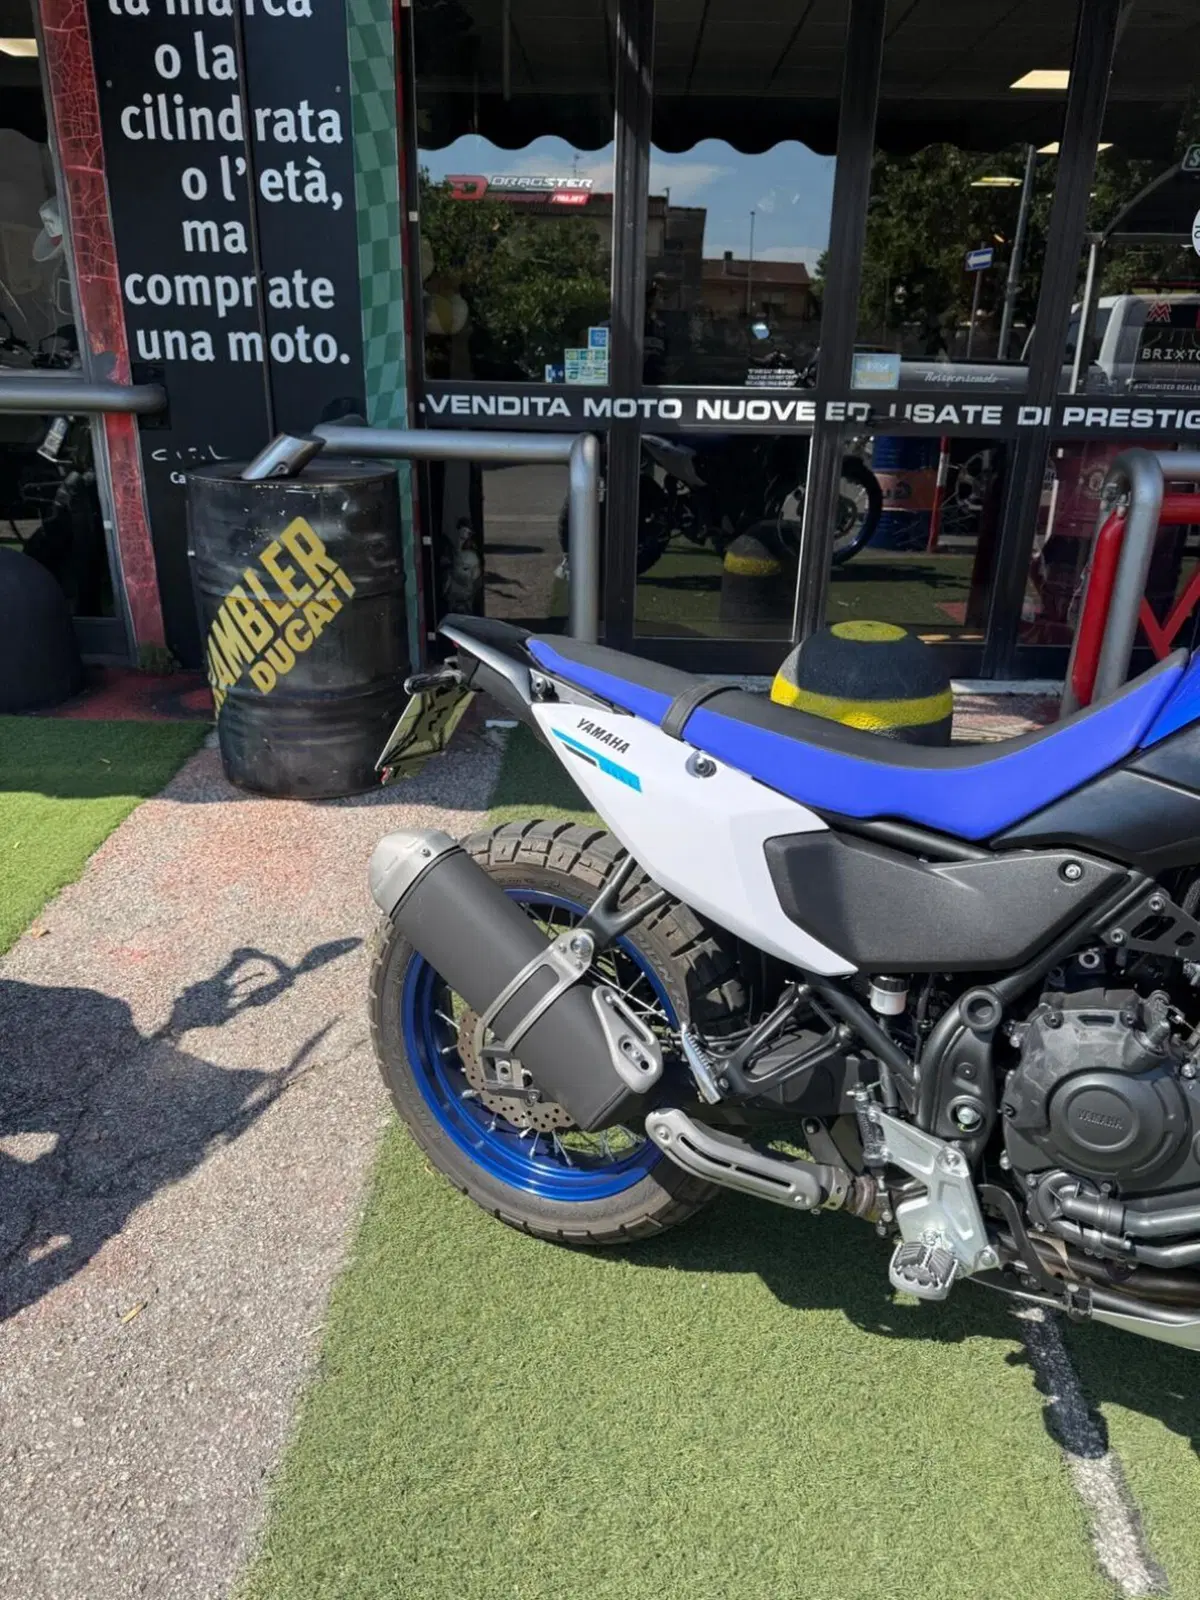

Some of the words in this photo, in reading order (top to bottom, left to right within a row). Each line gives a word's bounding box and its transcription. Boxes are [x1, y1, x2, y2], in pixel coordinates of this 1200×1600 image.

[154, 43, 181, 79] o
[194, 30, 238, 81] la
[181, 167, 208, 201] o
[491, 176, 594, 188] DRAGSTER
[182, 220, 248, 254] ma
[136, 329, 216, 362] una
[227, 325, 350, 365] moto.
[426, 394, 572, 418] VENDITA
[583, 397, 683, 420] MOTO
[695, 398, 817, 422] NUOVE
[889, 403, 1003, 425] USATE
[1017, 406, 1052, 426] DI
[1062, 407, 1200, 429] PRESTIG
[207, 516, 338, 720] AMBLER
[249, 568, 356, 696] DUCATI
[576, 718, 631, 754] YAMAHA
[1077, 1107, 1124, 1130] YAMAHA
